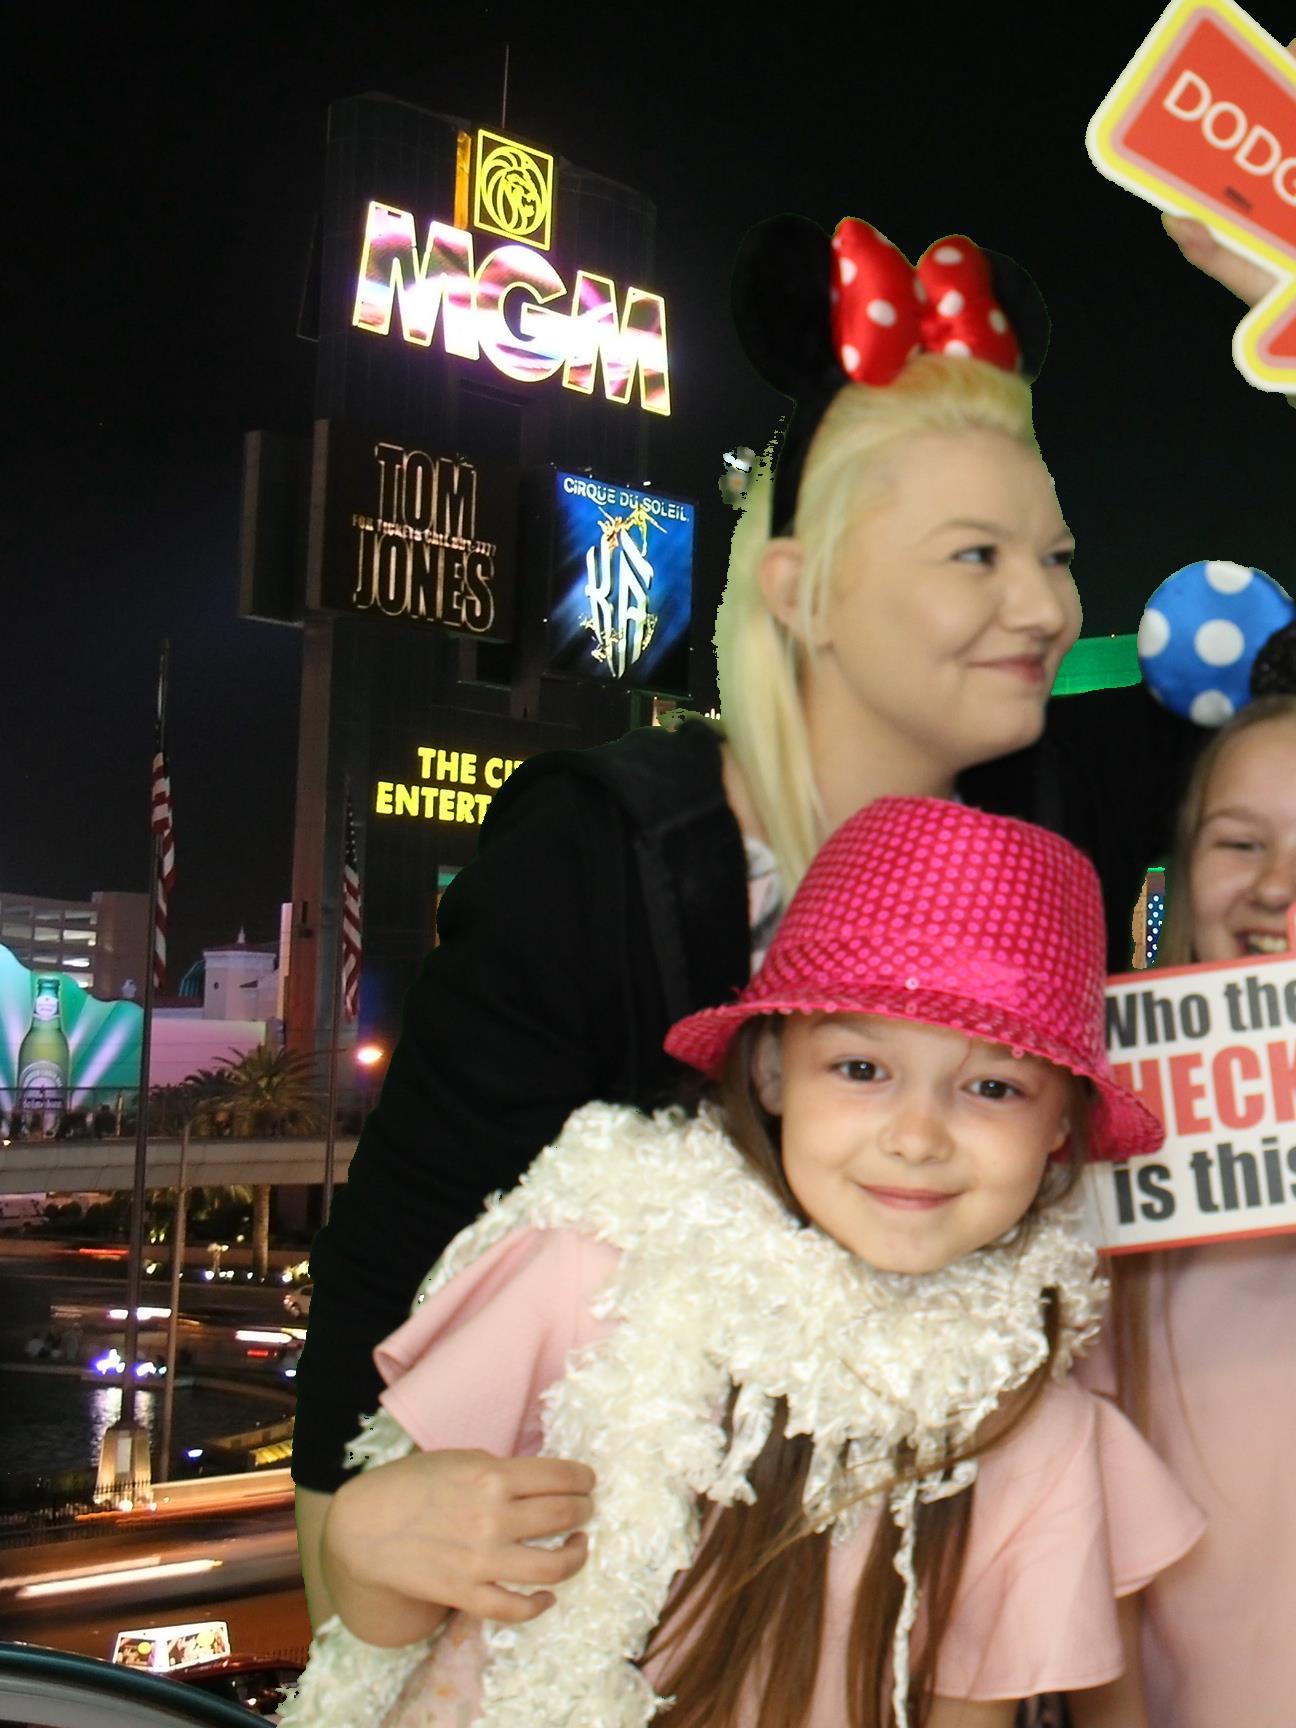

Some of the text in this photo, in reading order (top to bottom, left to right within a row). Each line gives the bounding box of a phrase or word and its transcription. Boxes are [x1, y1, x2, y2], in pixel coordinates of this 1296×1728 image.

[352, 200, 670, 416] MGM
[374, 442, 477, 540] TOM
[353, 531, 496, 633] JONES
[417, 747, 477, 785] THE
[1106, 990, 1211, 1051] Who
[1113, 1162, 1176, 1226] is
